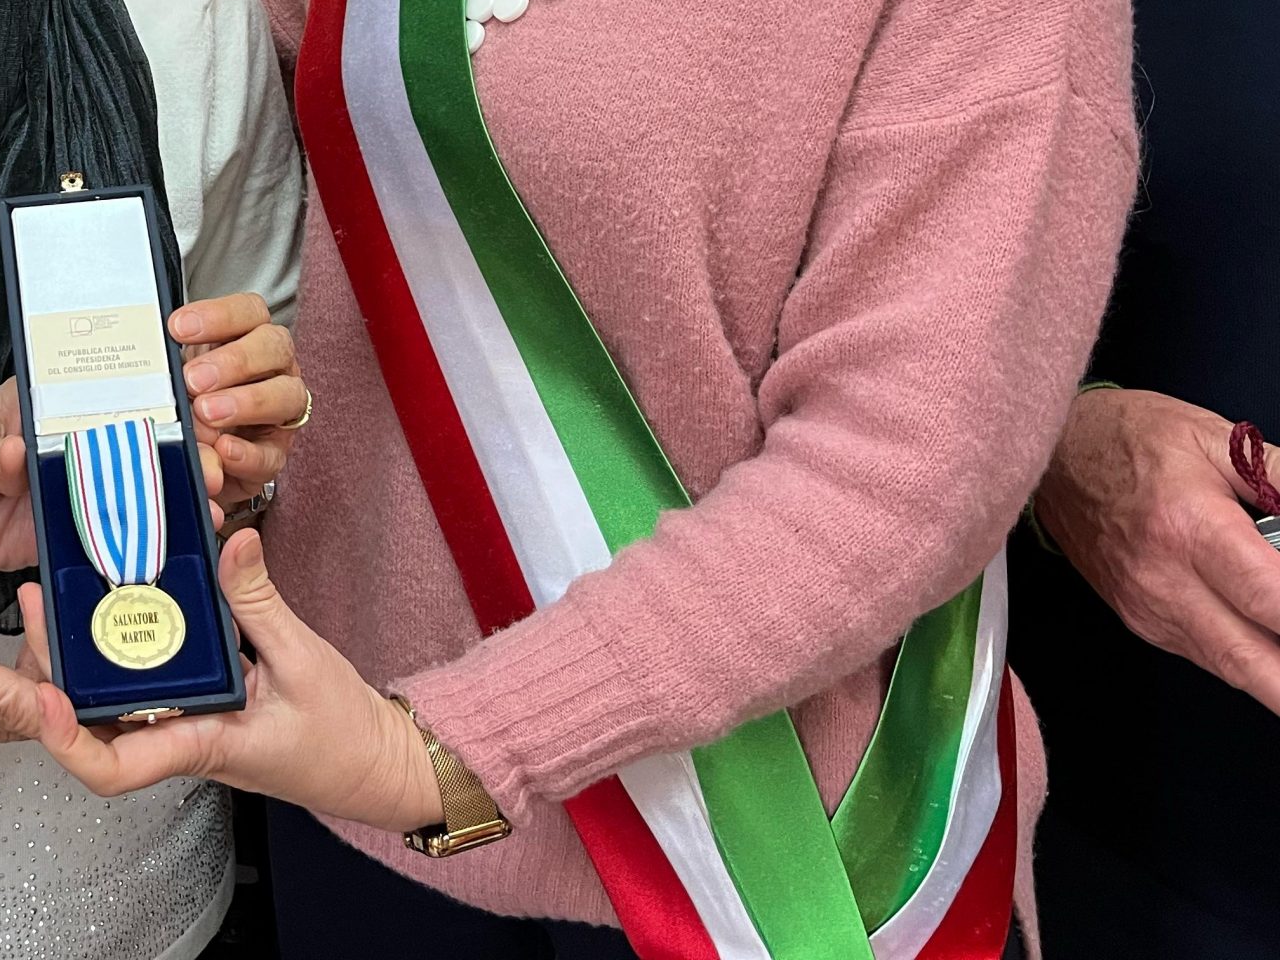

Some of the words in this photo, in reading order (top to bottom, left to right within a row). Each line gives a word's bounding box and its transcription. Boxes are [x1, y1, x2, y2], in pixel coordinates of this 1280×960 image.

[58, 347, 102, 358] REPUBBLICA
[104, 344, 136, 353] ITALIANA
[76, 354, 120, 364] PRESIDENZA
[48, 368, 61, 376] DEL
[63, 364, 102, 374] CONSIGLIO
[104, 362, 116, 371] DEI
[118, 360, 151, 369] MINISTRI
[113, 611, 160, 627] SALVATORE
[120, 629, 156, 644] MARTINI
